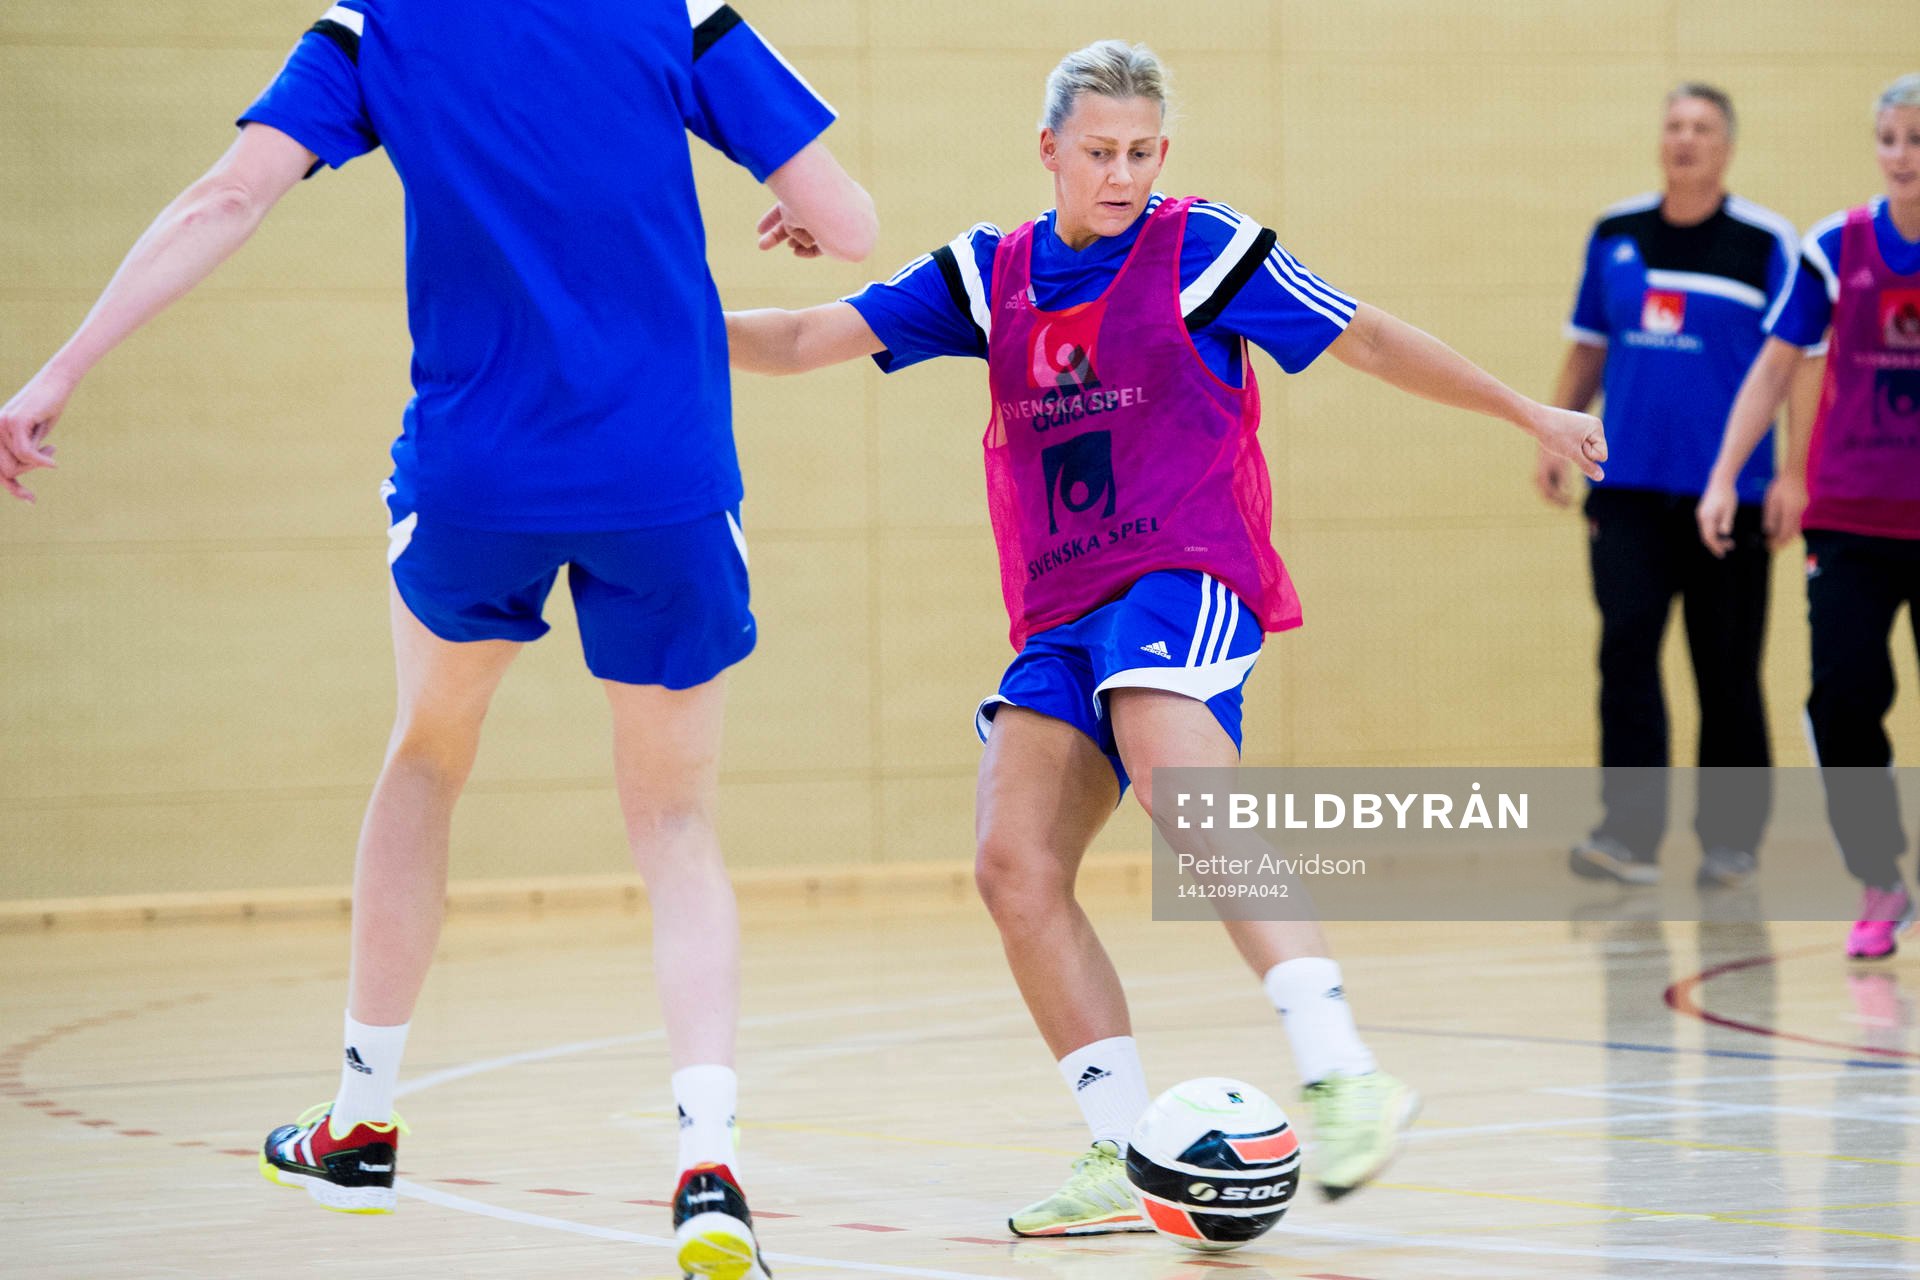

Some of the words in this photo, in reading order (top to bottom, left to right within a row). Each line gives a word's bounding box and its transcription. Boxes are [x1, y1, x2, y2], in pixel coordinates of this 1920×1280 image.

[1002, 395, 1084, 420] SVENSKA
[1090, 387, 1149, 411] SPEL
[1028, 535, 1101, 581] SVENSKA
[1108, 516, 1161, 544] SPEL
[1219, 1180, 1290, 1201] SOC
